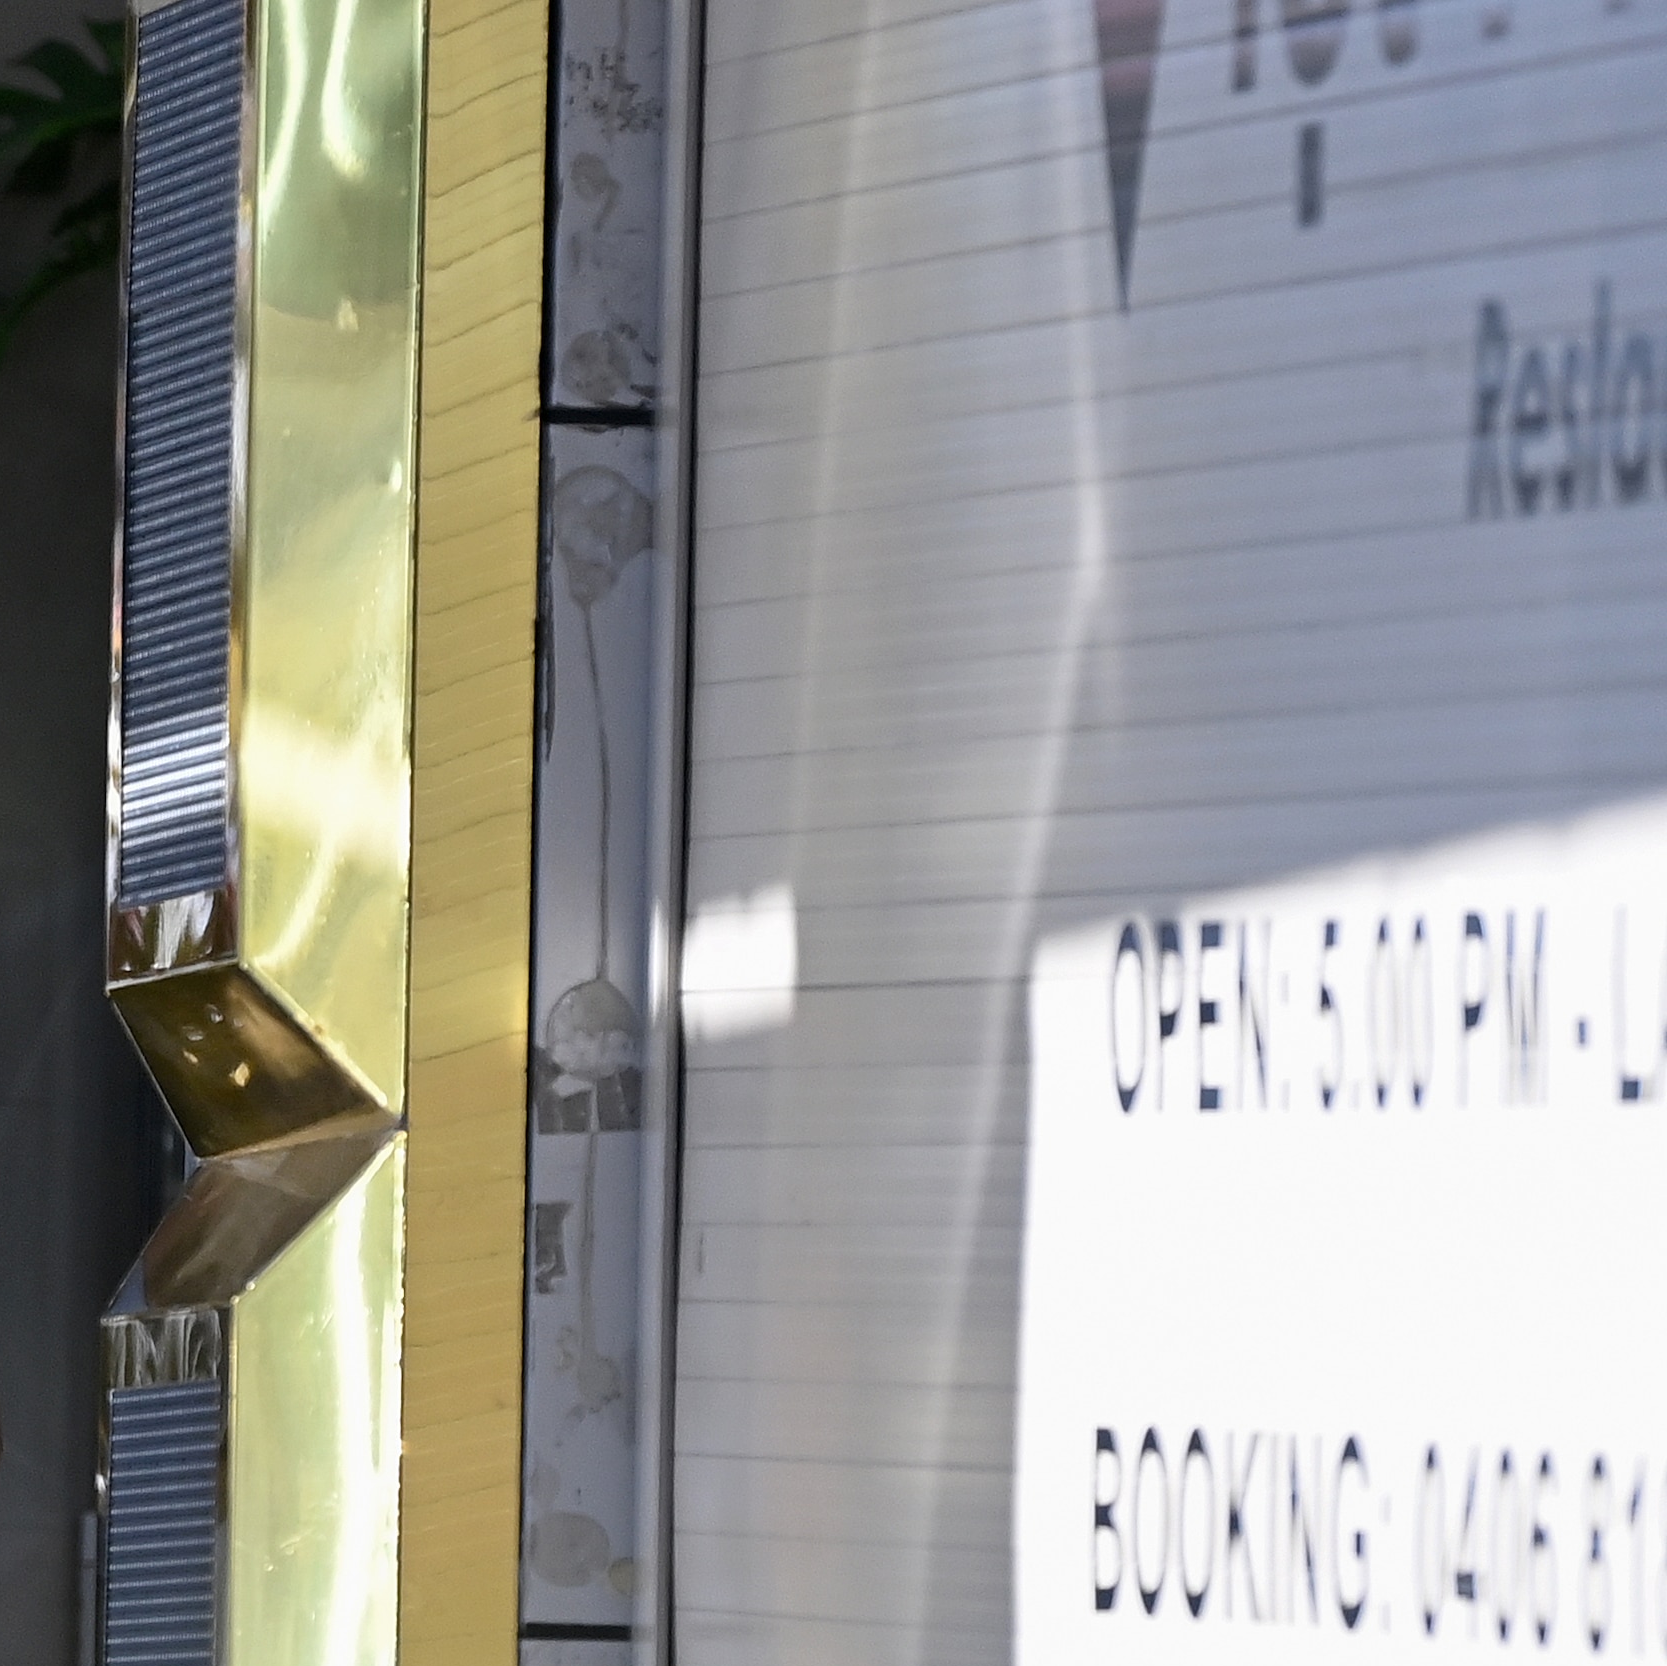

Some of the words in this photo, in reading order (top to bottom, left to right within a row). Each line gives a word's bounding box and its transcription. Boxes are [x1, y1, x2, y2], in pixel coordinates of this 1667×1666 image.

[1466, 274, 1666, 521] Resta
[1319, 914, 1434, 1112] 5.00
[1458, 906, 1550, 1110] PM
[1413, 1440, 1560, 1649] 0406
[1578, 1450, 1666, 1658] 81
